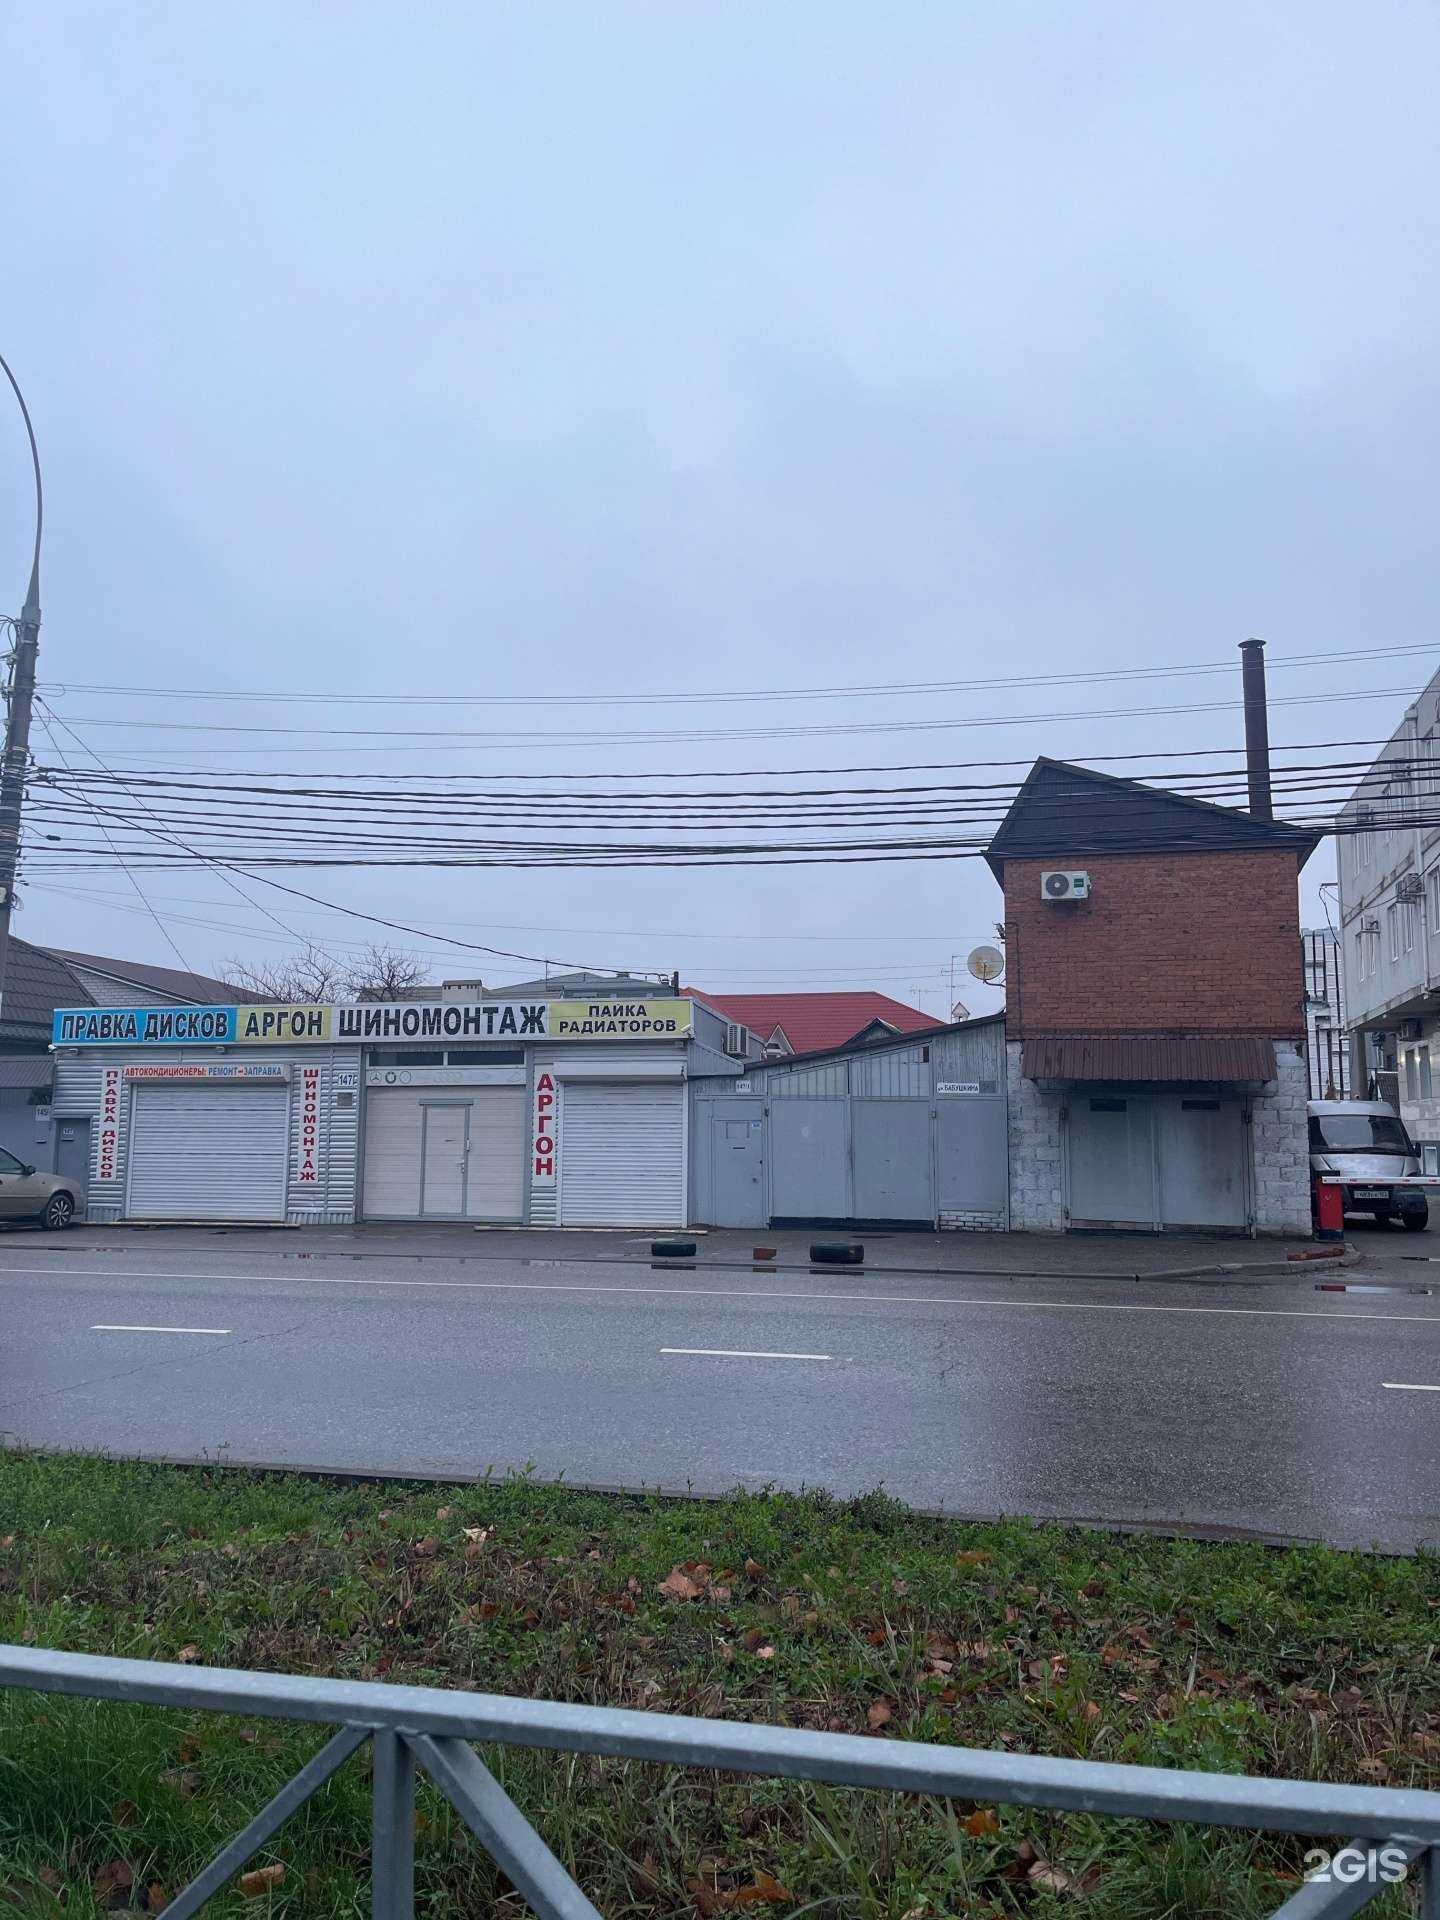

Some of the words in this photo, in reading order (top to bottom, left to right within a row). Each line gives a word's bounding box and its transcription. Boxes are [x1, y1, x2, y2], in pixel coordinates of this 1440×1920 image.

[245, 1011, 322, 1036] АРГОН
[338, 1005, 546, 1036] ШИНОМОНТАЖ
[588, 1004, 647, 1017] ПАЙКА
[61, 1014, 137, 1039] ПРАВКА
[144, 1012, 228, 1041] ДИСКОВ
[559, 1020, 676, 1034] РАДИАТОРОВ
[339, 1074, 353, 1085] 147
[104, 1070, 120, 1123] ПРАВКА
[300, 1069, 320, 1181] ШИНОМОНТАЖ
[535, 1073, 554, 1176] АРГОН
[101, 1131, 116, 1178] ДИСКОВ
